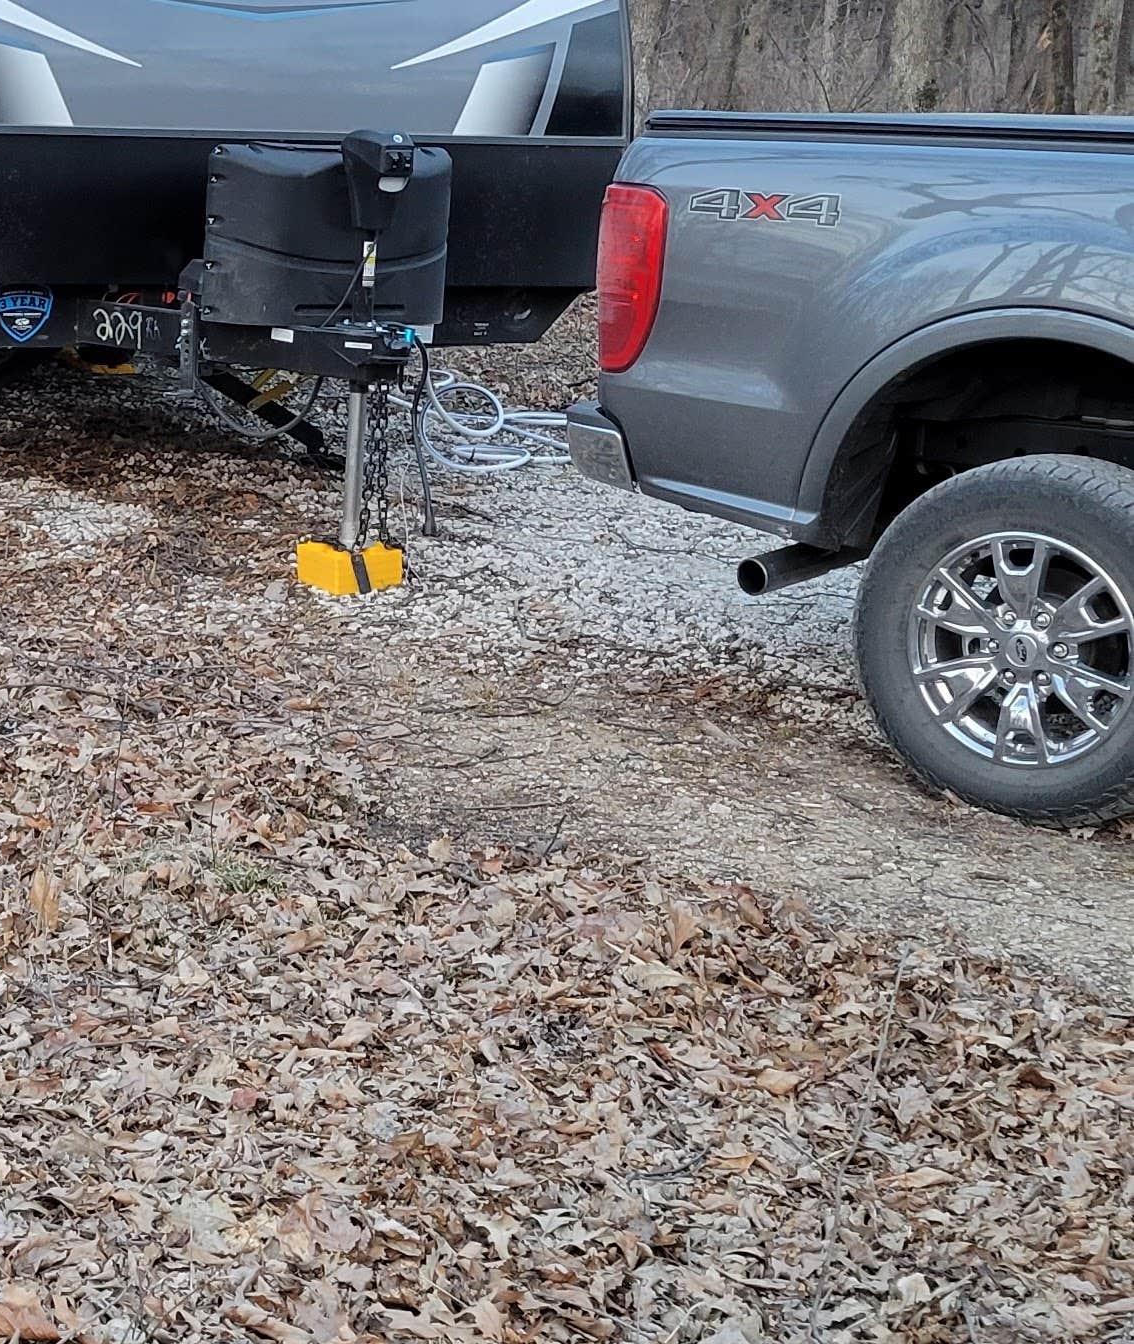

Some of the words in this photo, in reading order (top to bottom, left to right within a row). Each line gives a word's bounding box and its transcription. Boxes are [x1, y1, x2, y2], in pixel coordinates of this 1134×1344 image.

[0, 299, 7, 310] 3
[11, 296, 46, 310] YEAR
[92, 307, 144, 350] 229
